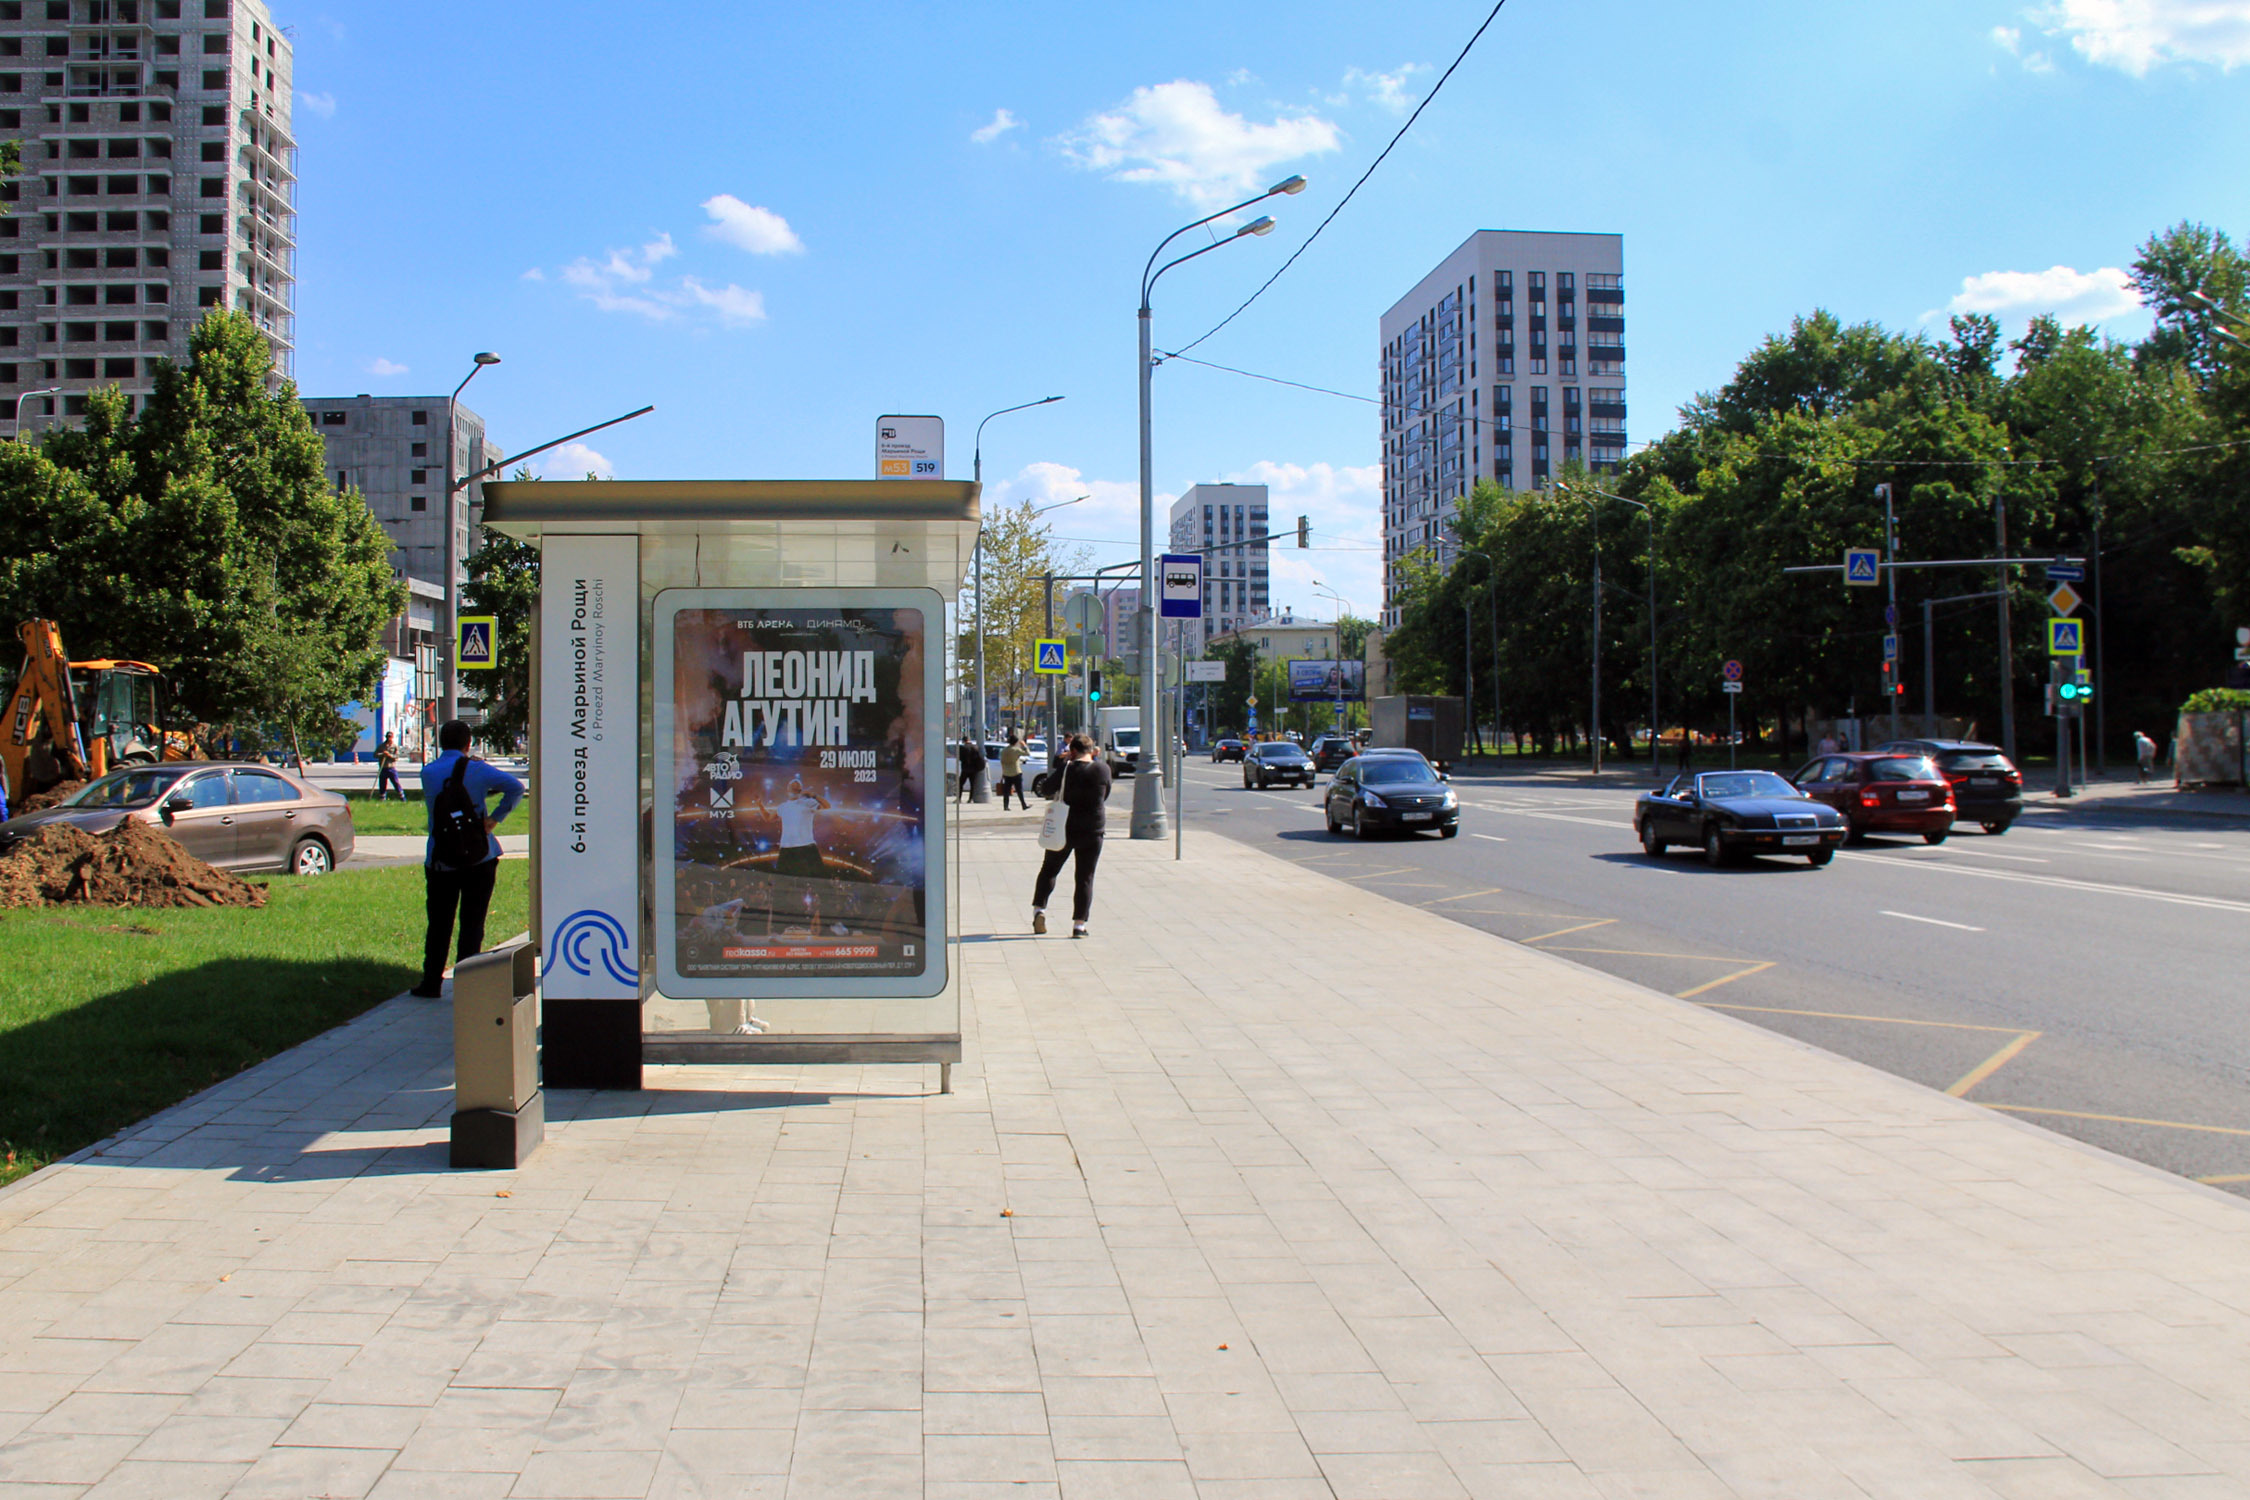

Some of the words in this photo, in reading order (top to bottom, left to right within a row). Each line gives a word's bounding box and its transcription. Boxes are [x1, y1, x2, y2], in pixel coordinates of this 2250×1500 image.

[916, 463, 936, 473] 519
[571, 579, 589, 631] Рощи
[592, 579, 603, 619] Roschi
[737, 620, 754, 629] ВТБ
[756, 620, 794, 629] АРЕНА
[806, 619, 861, 628] ДИНАМО
[592, 623, 606, 682] Maryinoy
[571, 637, 589, 739] Марьиной
[740, 650, 877, 703] ЛЕОНИД
[592, 686, 603, 729] Proezd
[14, 696, 31, 745] JCB
[721, 699, 849, 747] АГУТИН
[592, 733, 603, 742] 6
[702, 763, 729, 772] АВТО
[819, 751, 836, 769] 29
[838, 750, 876, 769] ИЮЛЯ
[574, 747, 589, 816] проезд
[710, 770, 743, 781] РАДИО
[854, 770, 877, 783] 2023
[709, 811, 736, 819] МУЗ
[571, 823, 586, 854] 6-й
[835, 947, 851, 956] 665
[853, 947, 876, 955] 9999
